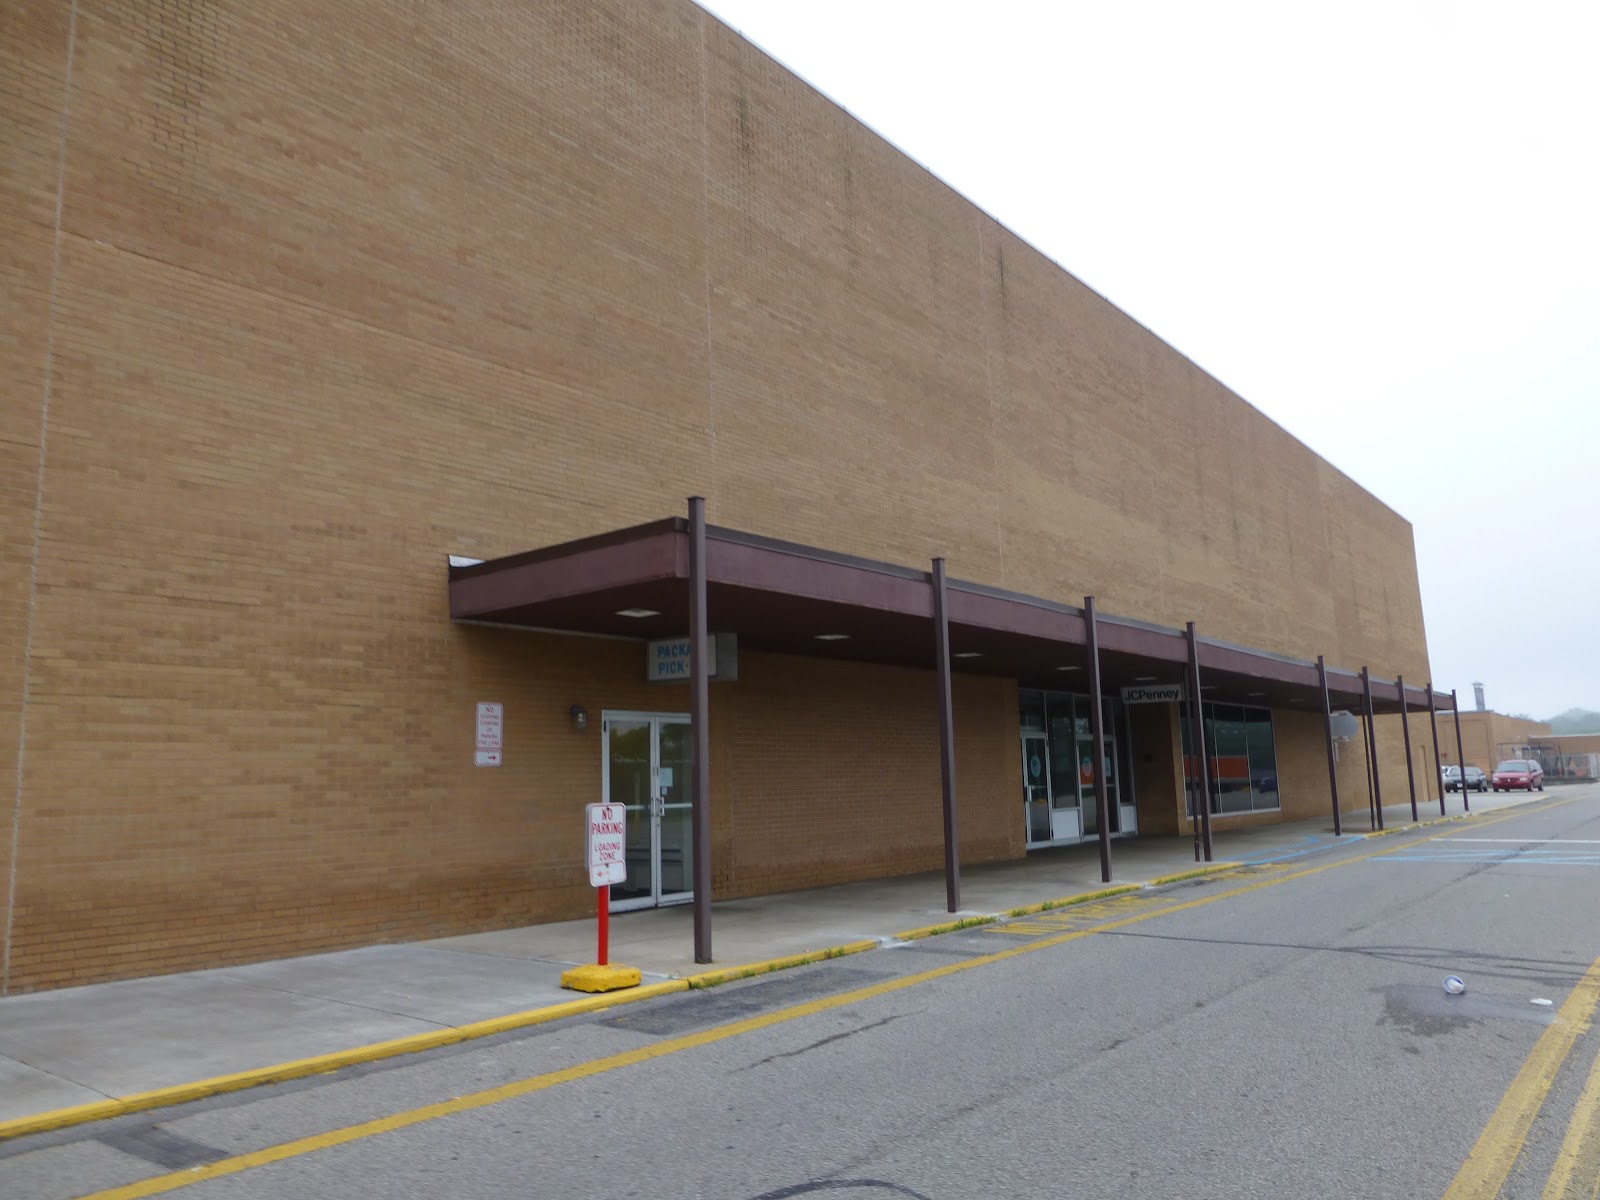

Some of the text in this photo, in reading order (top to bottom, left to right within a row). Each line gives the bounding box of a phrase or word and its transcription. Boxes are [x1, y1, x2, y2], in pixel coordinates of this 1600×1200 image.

[657, 644, 692, 658] PACKA
[658, 661, 689, 674] PICK-
[1124, 689, 1179, 701] JCPenney
[602, 808, 613, 820] NO
[591, 822, 622, 835] PARKING
[595, 842, 620, 852] LOADING
[600, 851, 615, 860] ZONE
